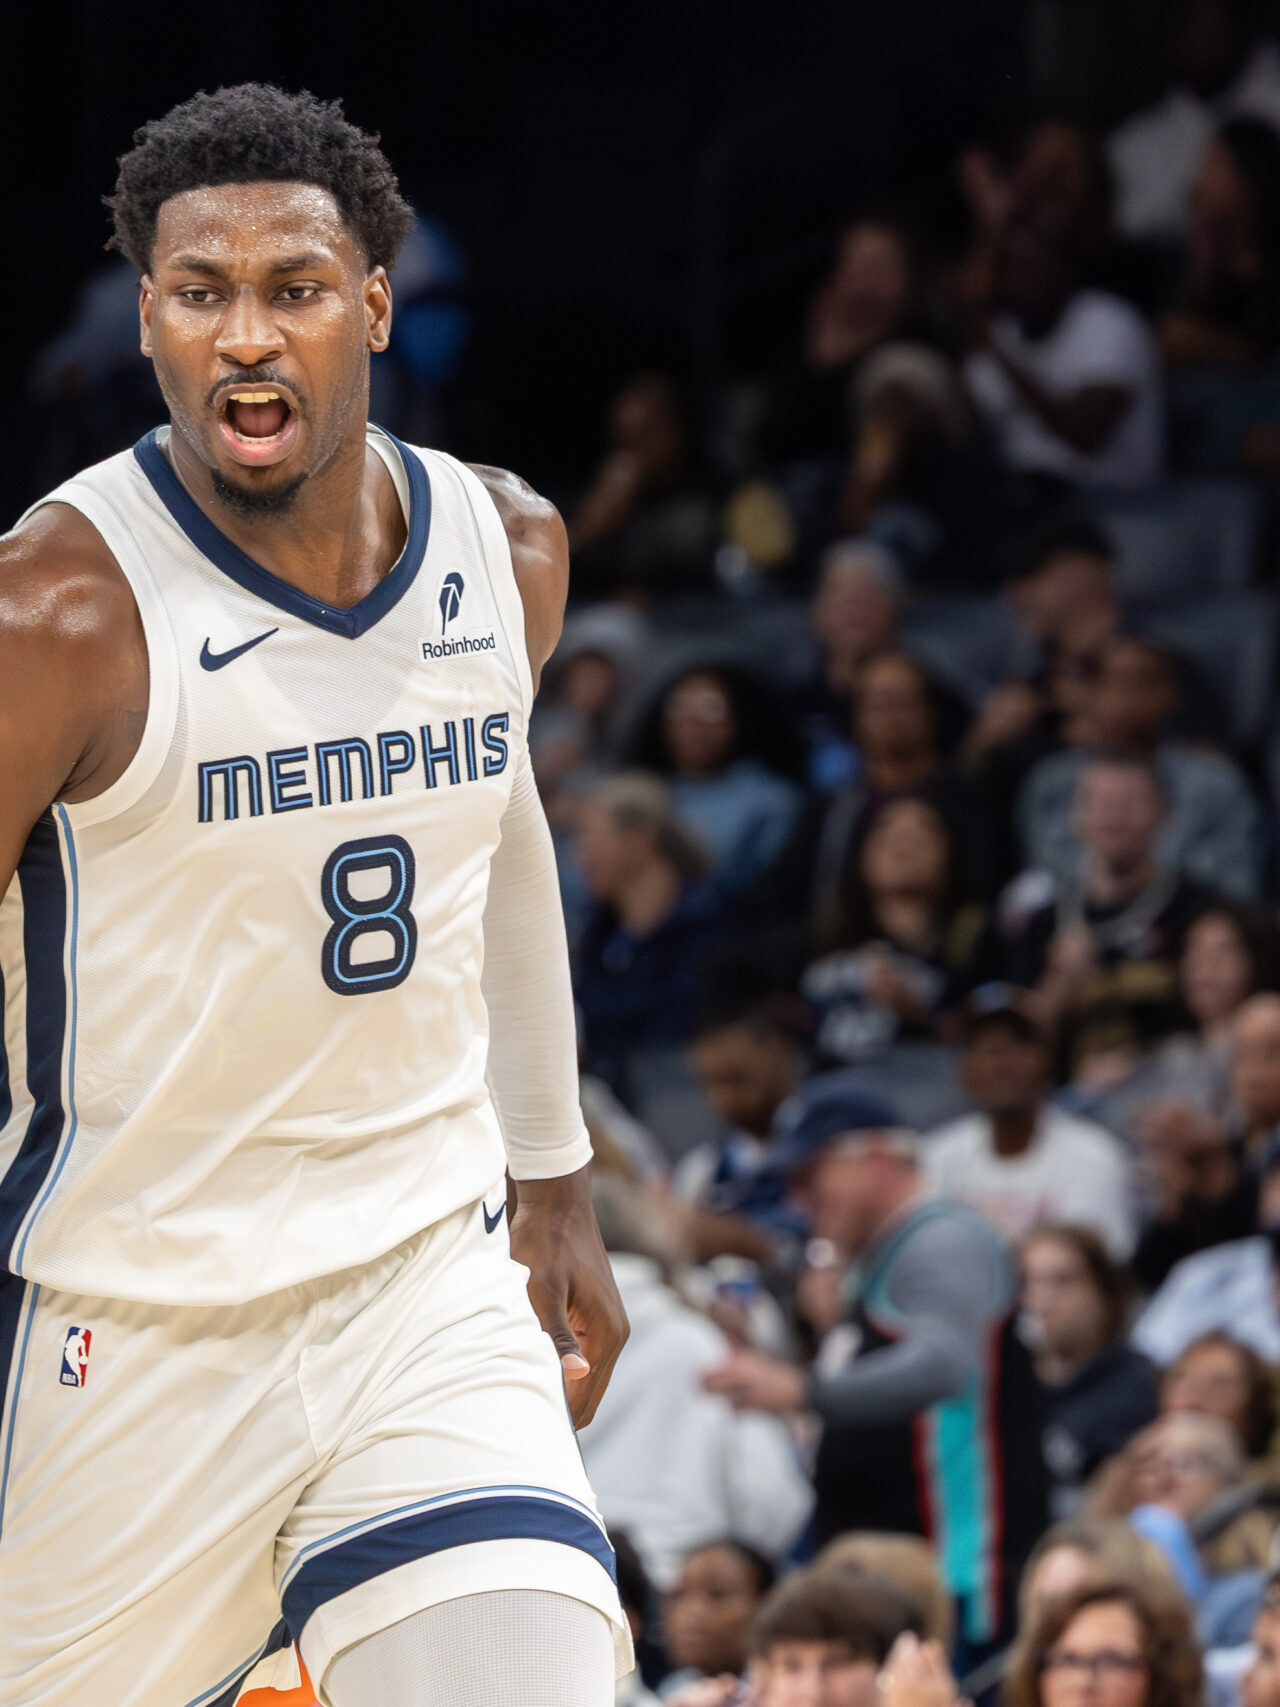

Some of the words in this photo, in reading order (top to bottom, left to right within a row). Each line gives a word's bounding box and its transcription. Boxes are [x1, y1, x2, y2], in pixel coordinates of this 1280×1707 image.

[422, 632, 495, 659] Robinhood
[197, 711, 509, 822] MEMPHIS
[321, 834, 418, 996] 8
